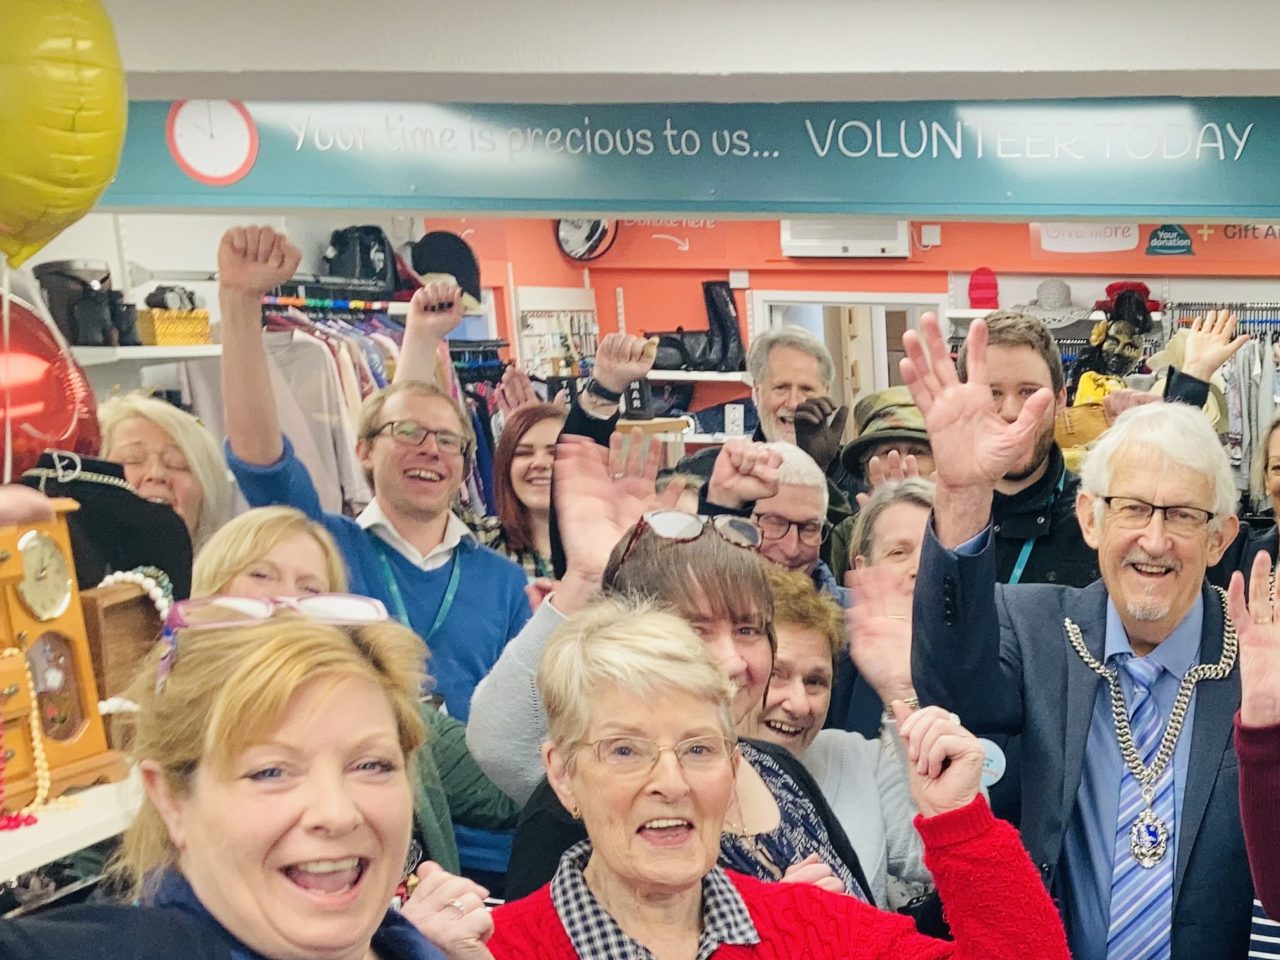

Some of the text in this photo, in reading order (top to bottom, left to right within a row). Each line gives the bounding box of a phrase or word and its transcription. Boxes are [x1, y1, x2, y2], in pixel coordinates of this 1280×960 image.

[291, 112, 1254, 163] Your time is precious to us... VOLUNTEER TODAY
[1089, 224, 1131, 240] more
[1157, 230, 1178, 240] Your
[1223, 224, 1260, 240] Gift
[1150, 238, 1191, 247] donation
